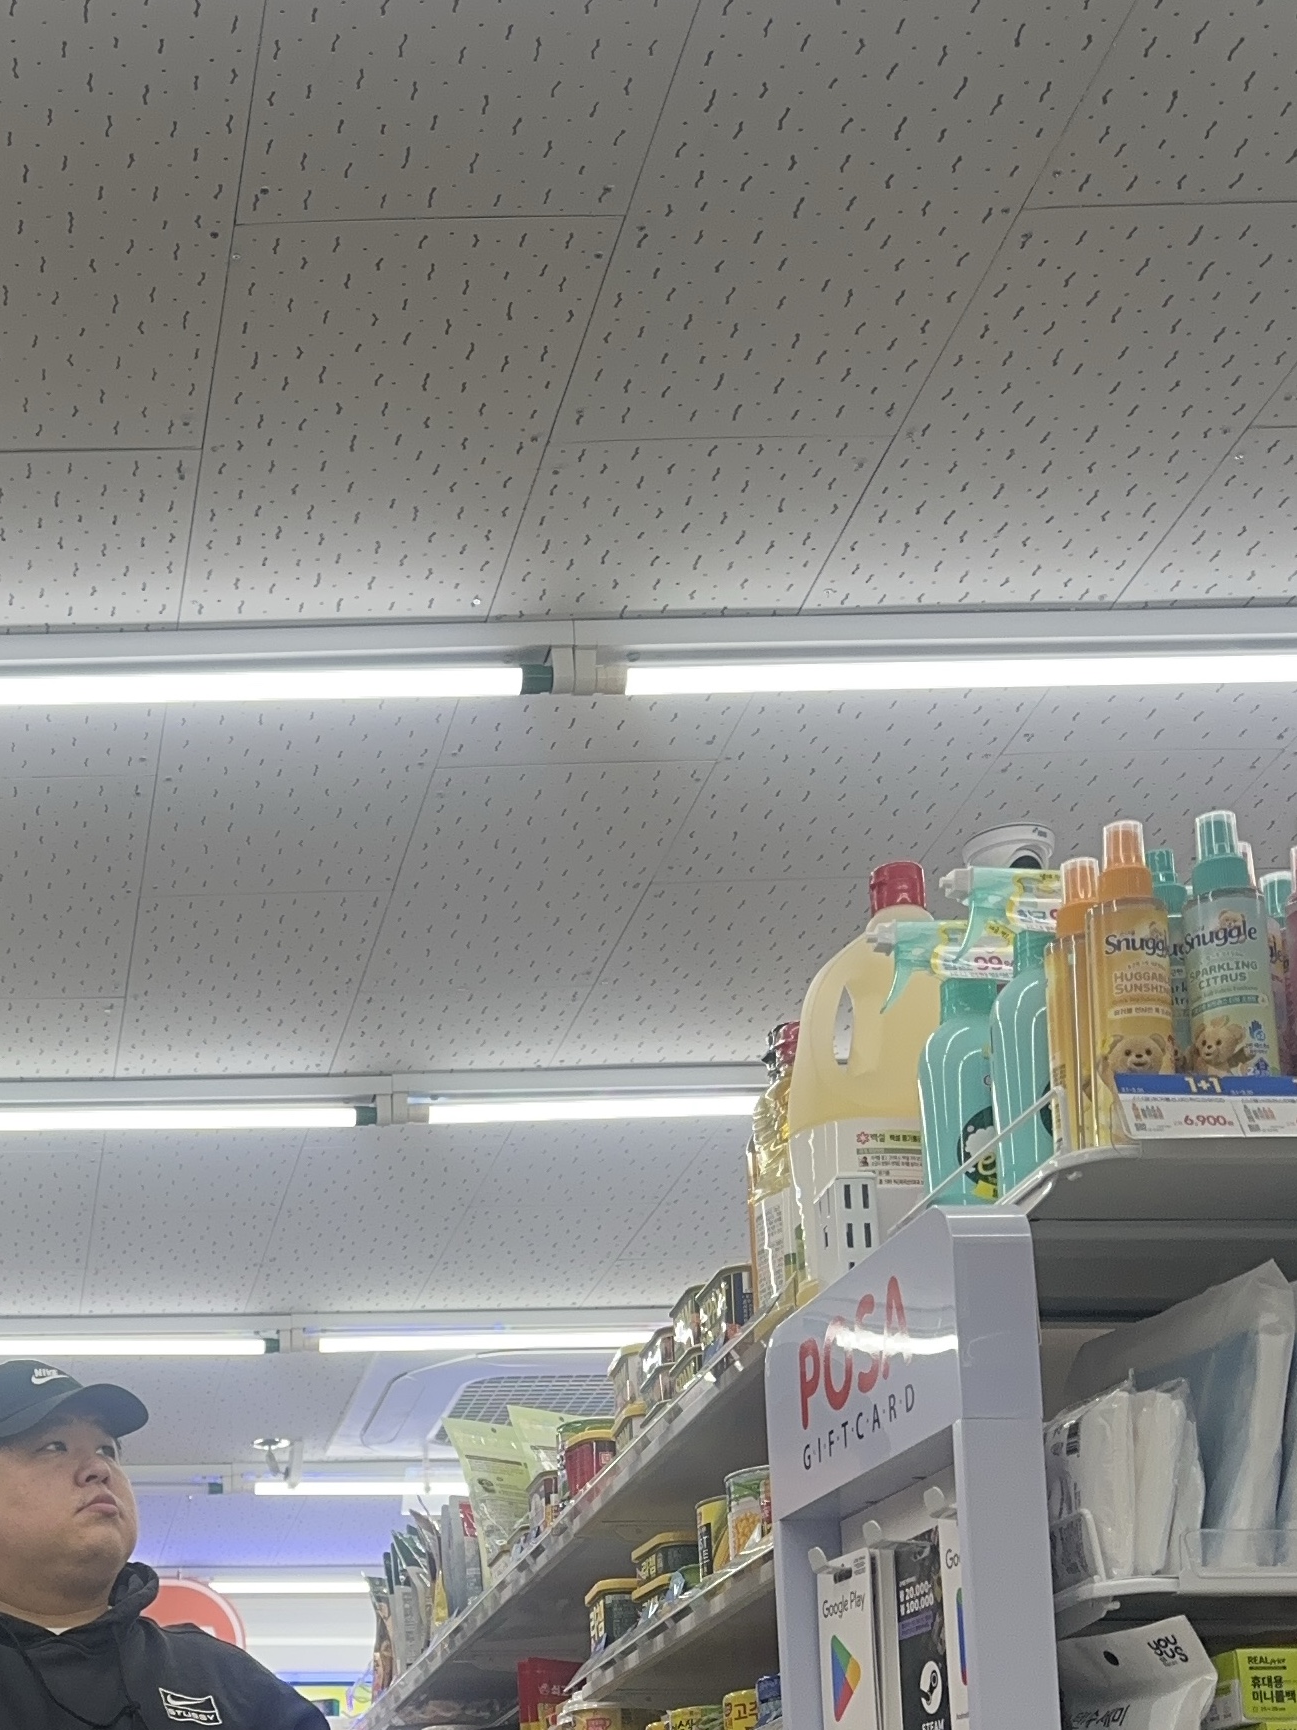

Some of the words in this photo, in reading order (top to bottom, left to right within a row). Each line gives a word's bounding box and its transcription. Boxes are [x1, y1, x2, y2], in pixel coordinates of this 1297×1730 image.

[1105, 929, 1169, 959] Snuggl
[1184, 918, 1258, 955] Snuggle
[1190, 960, 1258, 982] SPARKLING
[1113, 983, 1170, 995] SUNSHIN
[1198, 971, 1247, 991] CITRUS
[1184, 1075, 1223, 1094] 1+1
[1183, 1114, 1227, 1127] 6,900
[798, 1275, 910, 1430] POSA
[33, 1368, 59, 1379] NIKE
[822, 1594, 849, 1619] Google
[850, 1590, 866, 1613] Play
[1247, 1655, 1269, 1665] REAL
[1251, 1675, 1283, 1689] 휴대용
[168, 1707, 216, 1722] STUSSY
